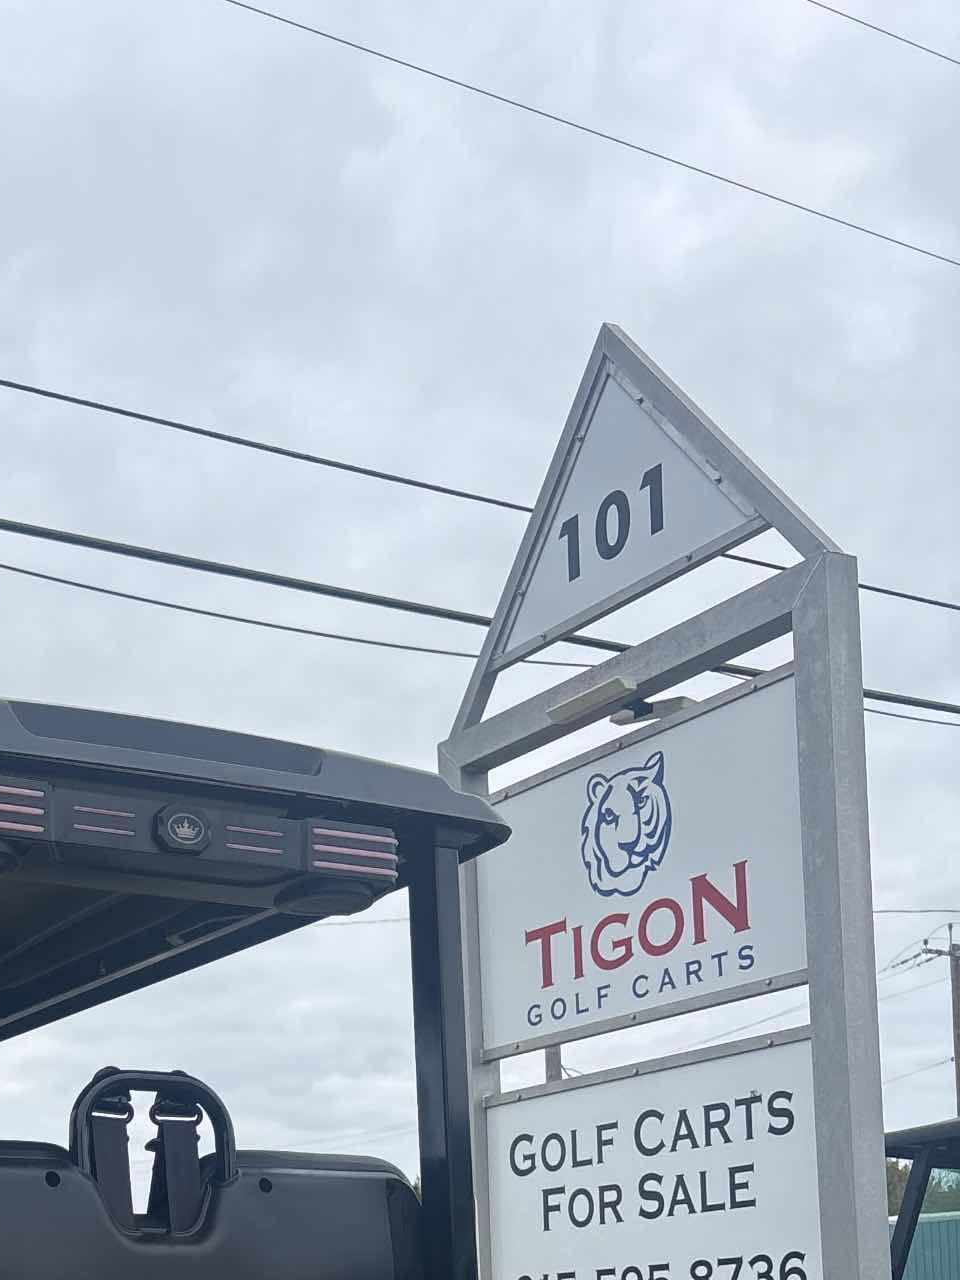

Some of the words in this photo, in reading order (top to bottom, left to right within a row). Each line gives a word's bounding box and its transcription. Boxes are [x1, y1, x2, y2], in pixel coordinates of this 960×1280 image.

[558, 463, 664, 583] 101
[524, 860, 751, 989] TIGON
[527, 984, 611, 1026] GOLF
[631, 944, 755, 999] CARTS
[509, 1120, 619, 1177] GOLF
[634, 1090, 795, 1157] CARTS
[541, 1184, 624, 1232] FOR
[638, 1163, 757, 1220] SALE
